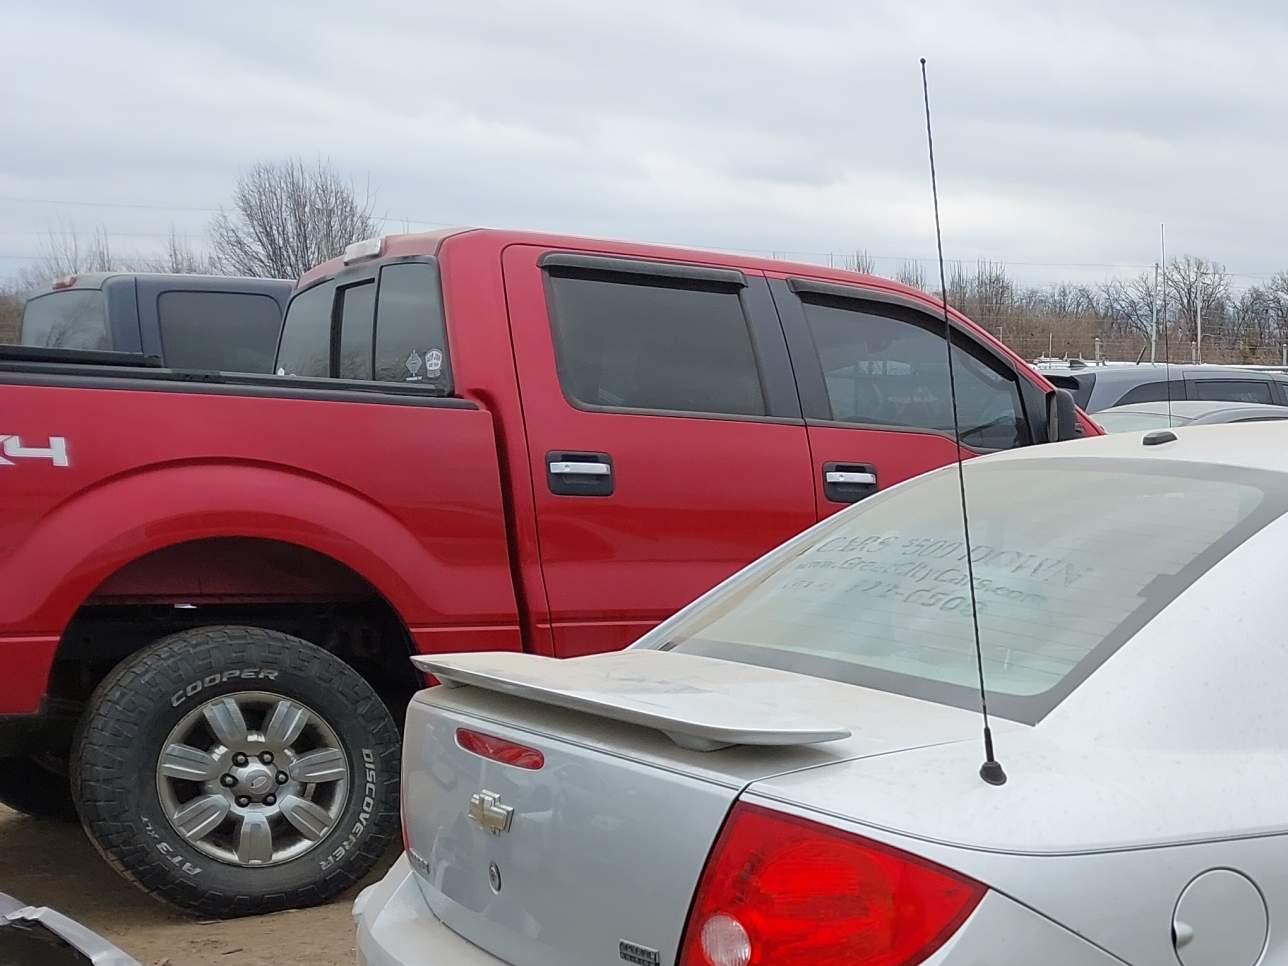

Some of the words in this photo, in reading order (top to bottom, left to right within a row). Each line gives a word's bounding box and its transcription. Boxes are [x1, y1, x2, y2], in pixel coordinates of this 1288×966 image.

[170, 668, 280, 709] COOPER
[319, 748, 377, 871] DISCOVERER
[156, 841, 204, 876] AT3
